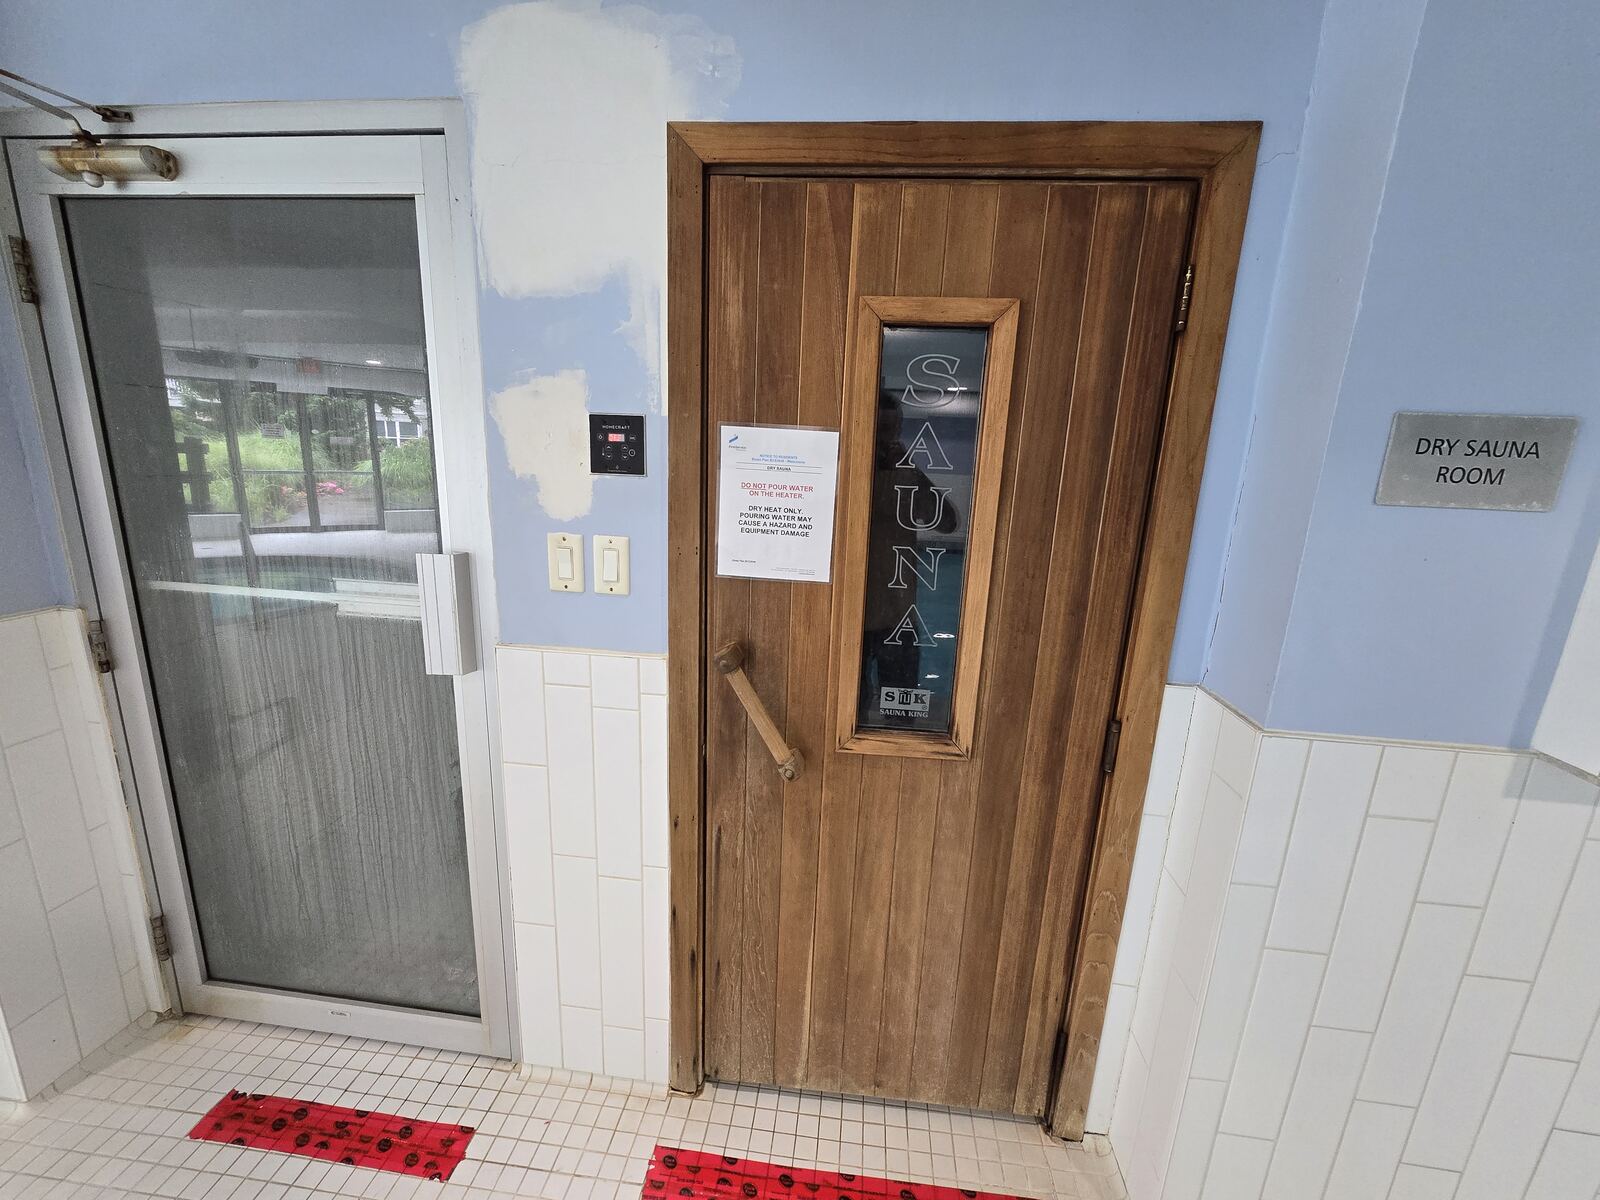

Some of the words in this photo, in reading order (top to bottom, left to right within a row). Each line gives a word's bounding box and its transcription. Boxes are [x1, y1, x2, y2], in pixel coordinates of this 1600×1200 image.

[1415, 437, 1461, 456] DRY
[1463, 439, 1540, 459] SAUNA
[1436, 466, 1505, 485] ROOM
[775, 492, 804, 500] HEATER.
[883, 353, 962, 648] SAUNA
[783, 507, 803, 515] ONLY.
[740, 527, 779, 535] EQUIPMENT
[780, 529, 810, 537] DAMAGE
[880, 708, 906, 717] SAUNA
